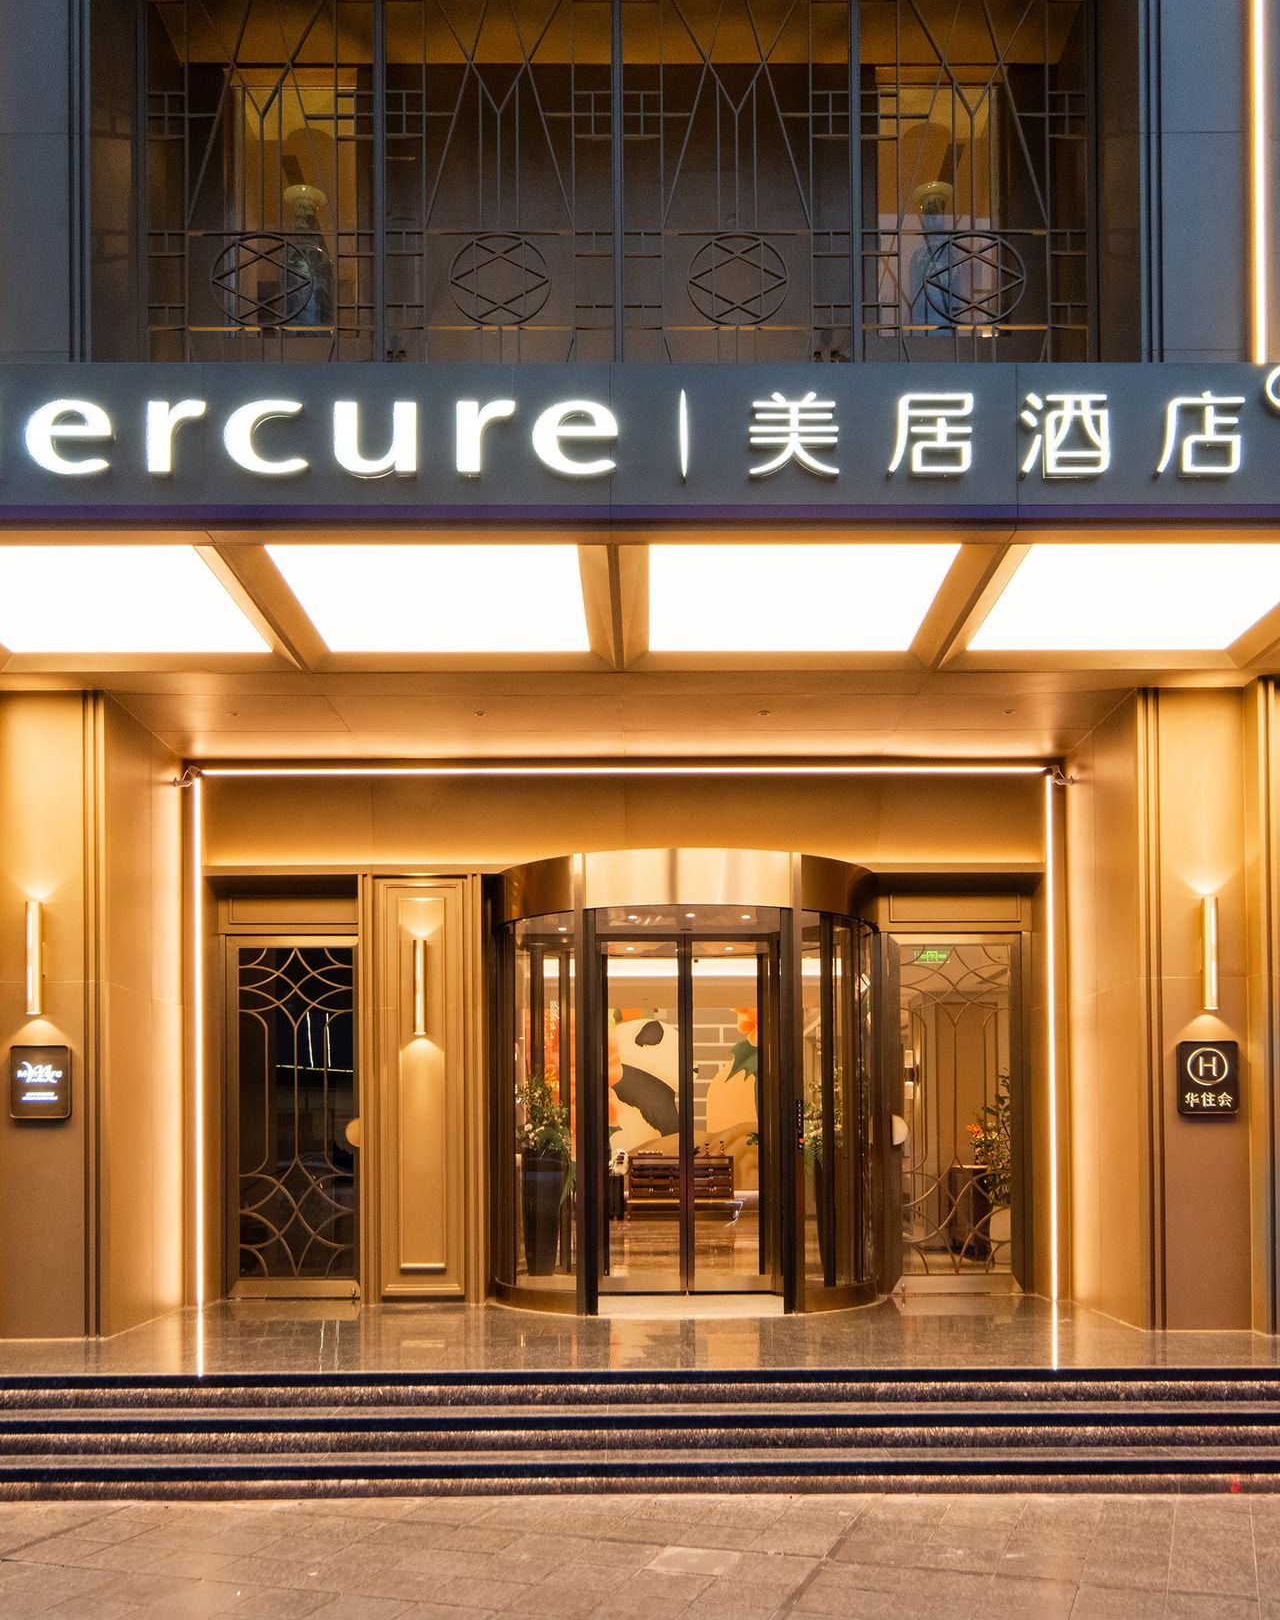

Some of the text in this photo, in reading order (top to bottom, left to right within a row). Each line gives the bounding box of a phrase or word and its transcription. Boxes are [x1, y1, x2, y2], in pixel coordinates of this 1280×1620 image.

[748, 390, 1247, 475] 美居酒店
[1184, 1091, 1233, 1108] 华住会
